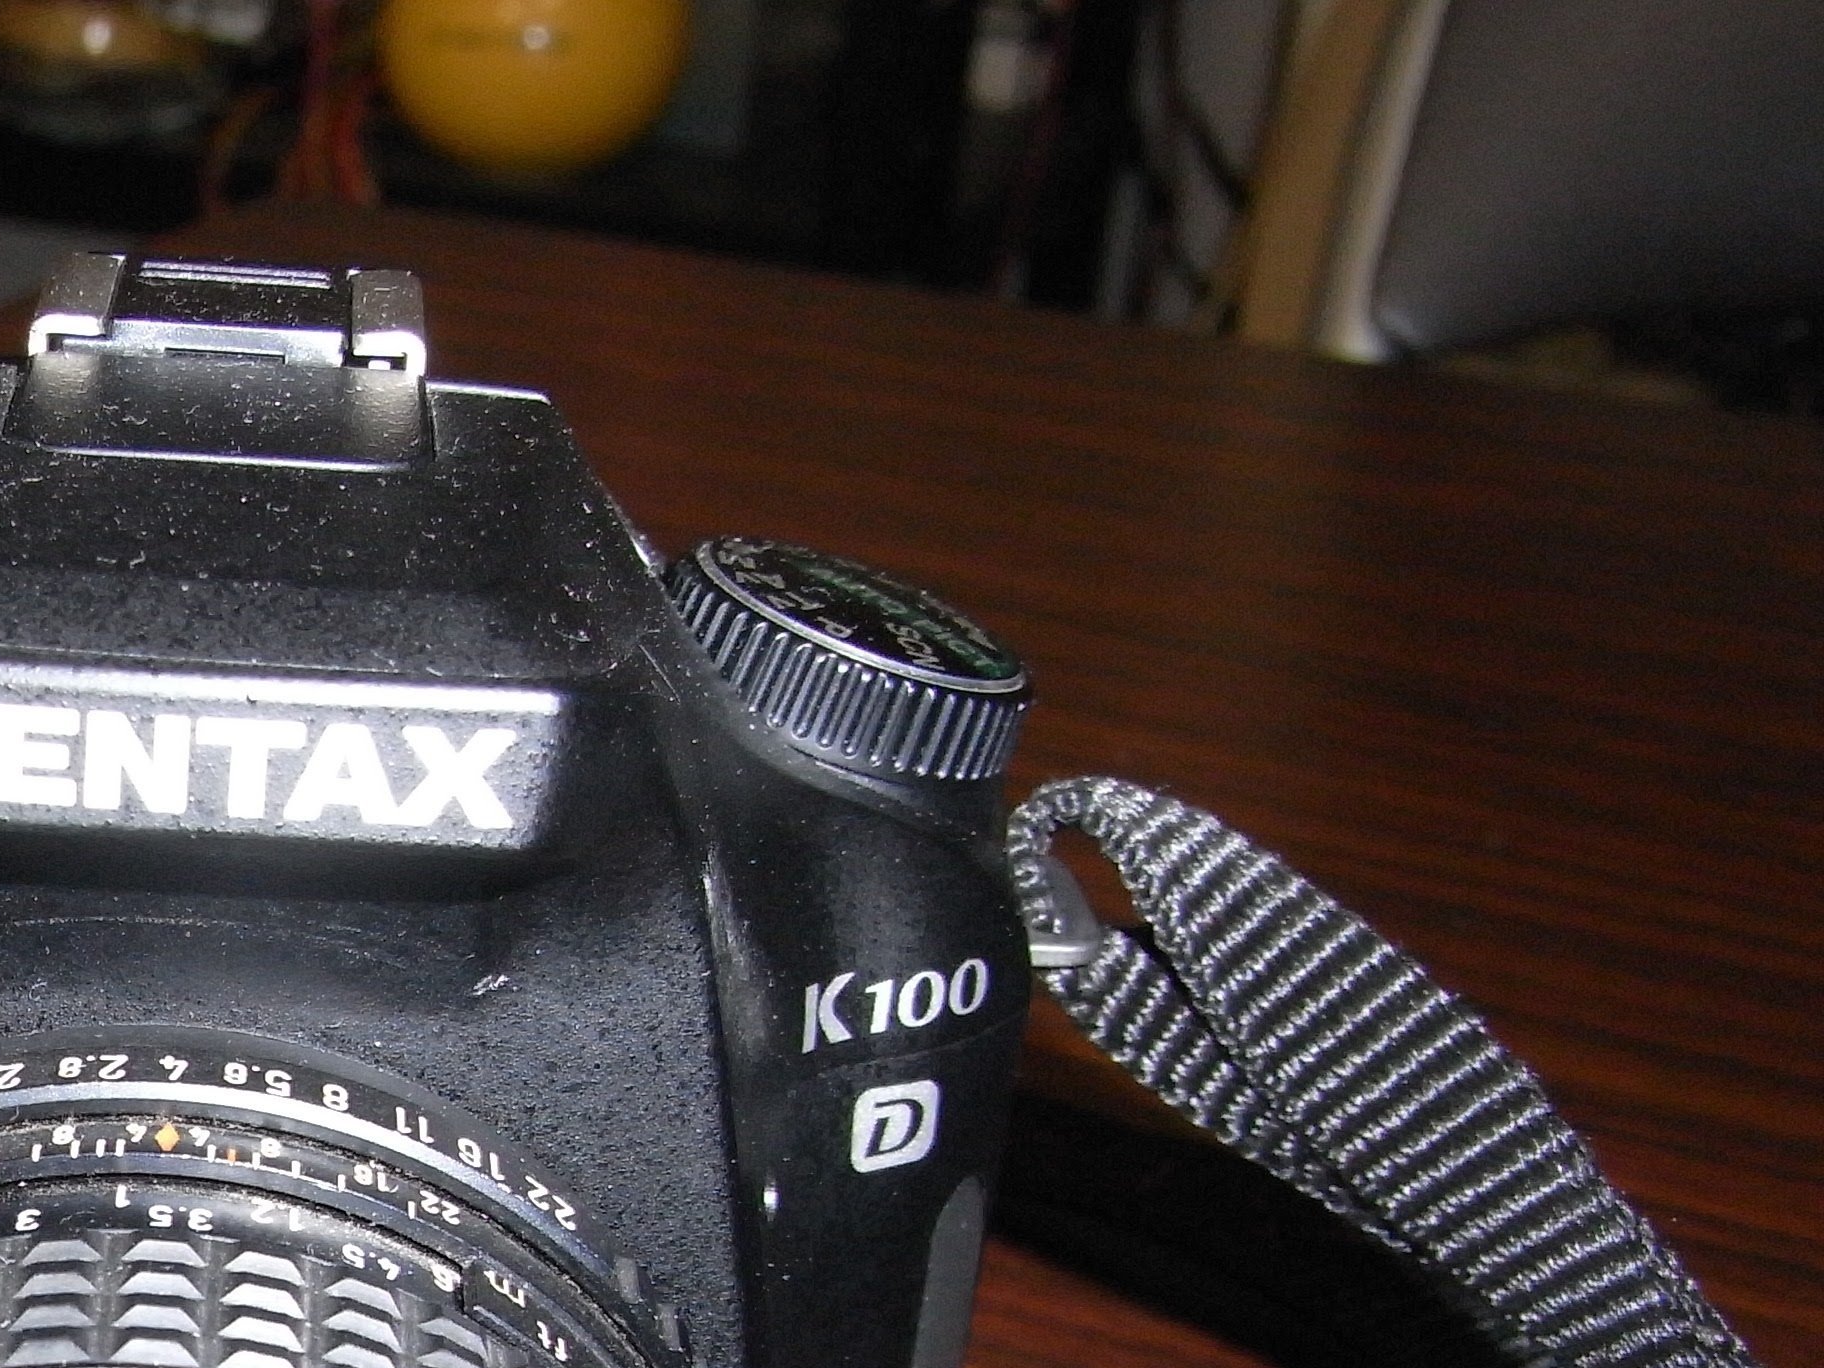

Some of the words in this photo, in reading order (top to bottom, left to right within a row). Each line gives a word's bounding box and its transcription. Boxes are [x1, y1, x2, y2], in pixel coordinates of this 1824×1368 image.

[885, 621, 947, 672] SCN
[58, 1055, 129, 1080] 2.8
[159, 1055, 189, 1081] 4
[223, 1062, 292, 1097] 5.6
[322, 1083, 349, 1112] 8
[52, 1124, 76, 1145] 8
[126, 1123, 148, 1143] 4
[189, 1127, 210, 1147] 4
[395, 1107, 435, 1144] 11
[858, 1092, 930, 1164] D
[260, 1138, 282, 1158] 8
[458, 1138, 505, 1181] 16
[353, 1164, 391, 1193] 16
[114, 1185, 131, 1209] 1
[419, 1189, 461, 1225] 22
[525, 1175, 576, 1231] 22
[15, 1209, 42, 1232] 3
[148, 1204, 214, 1232] 3.5
[341, 1243, 401, 1281] 4.5
[483, 1270, 527, 1308] m
[536, 1320, 569, 1362] ft
